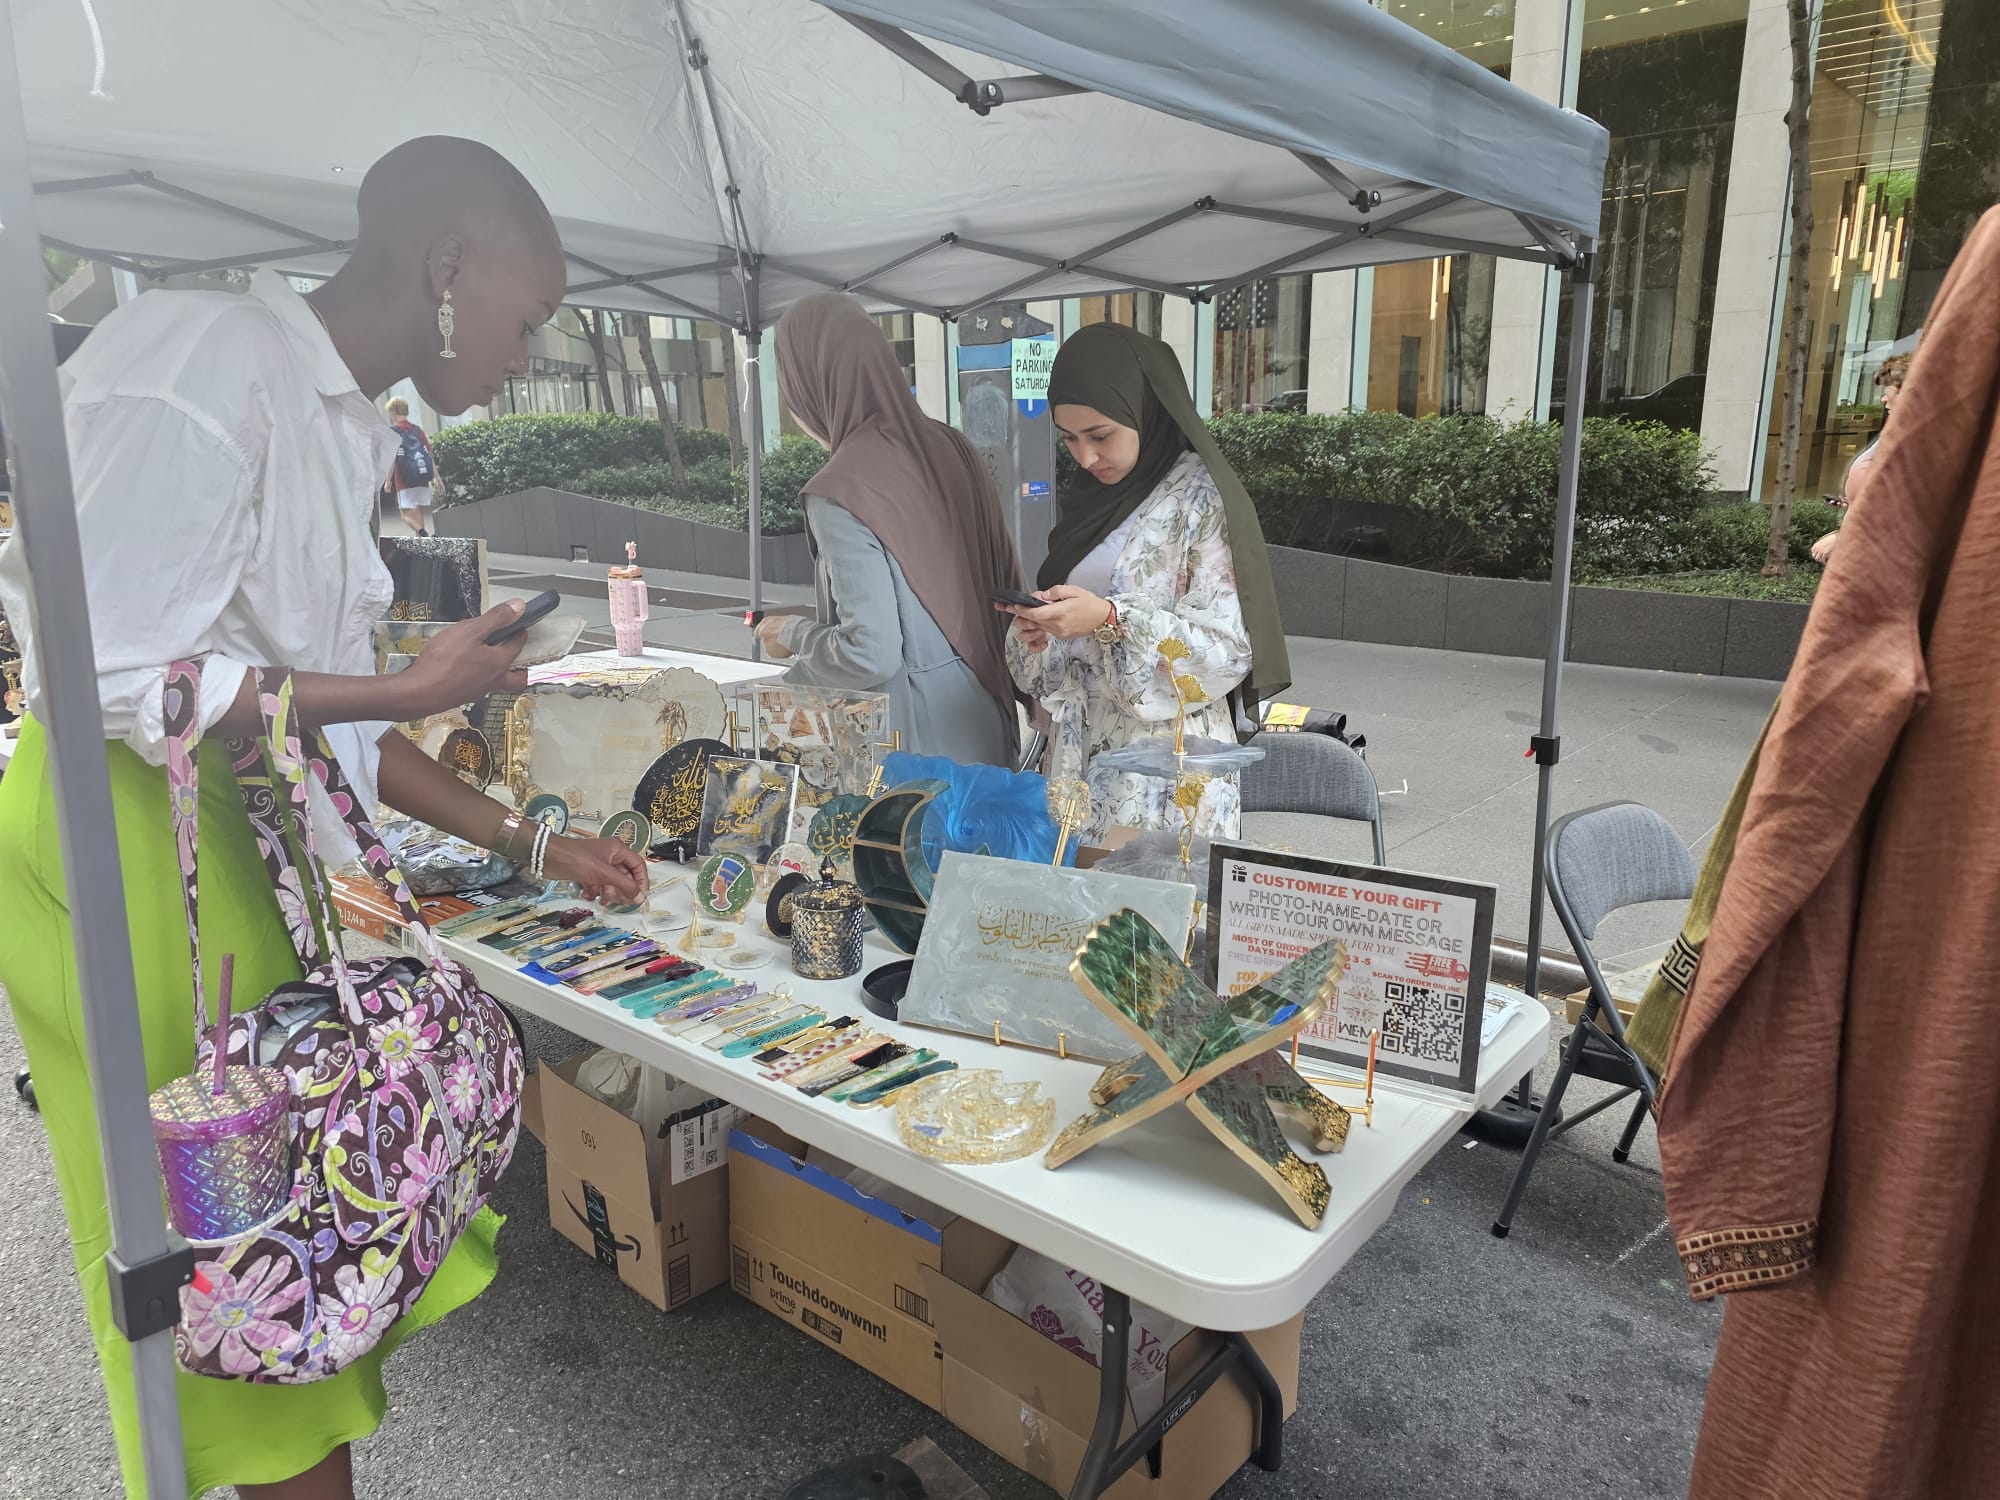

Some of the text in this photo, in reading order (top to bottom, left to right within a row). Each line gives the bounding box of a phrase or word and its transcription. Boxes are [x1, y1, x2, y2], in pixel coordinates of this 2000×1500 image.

[1029, 342, 1041, 357] NO
[1015, 377, 1049, 390] SATURDA
[1252, 872, 1443, 914] CUSTOMIZE YOUR GIFT
[1248, 888, 1443, 935] PHOTO-NAME-DATE OR
[1228, 899, 1464, 955] WRITE YOUR OWN MESSAGE
[1231, 933, 1259, 945] MOST
[1261, 939, 1275, 948] OF
[1276, 942, 1312, 954] ORDER
[1245, 922, 1275, 935] GIFTS
[1276, 926, 1306, 940] MADE
[1351, 941, 1374, 955] FOR
[1247, 944, 1275, 957] DAYS
[1276, 951, 1287, 960] IN
[1235, 970, 1258, 984] FOR
[1405, 977, 1432, 988] ORDER
[769, 1262, 887, 1343] Touchdoowwnn!
[770, 1288, 796, 1310] prime
[1164, 1395, 1193, 1426] LIFETIME
